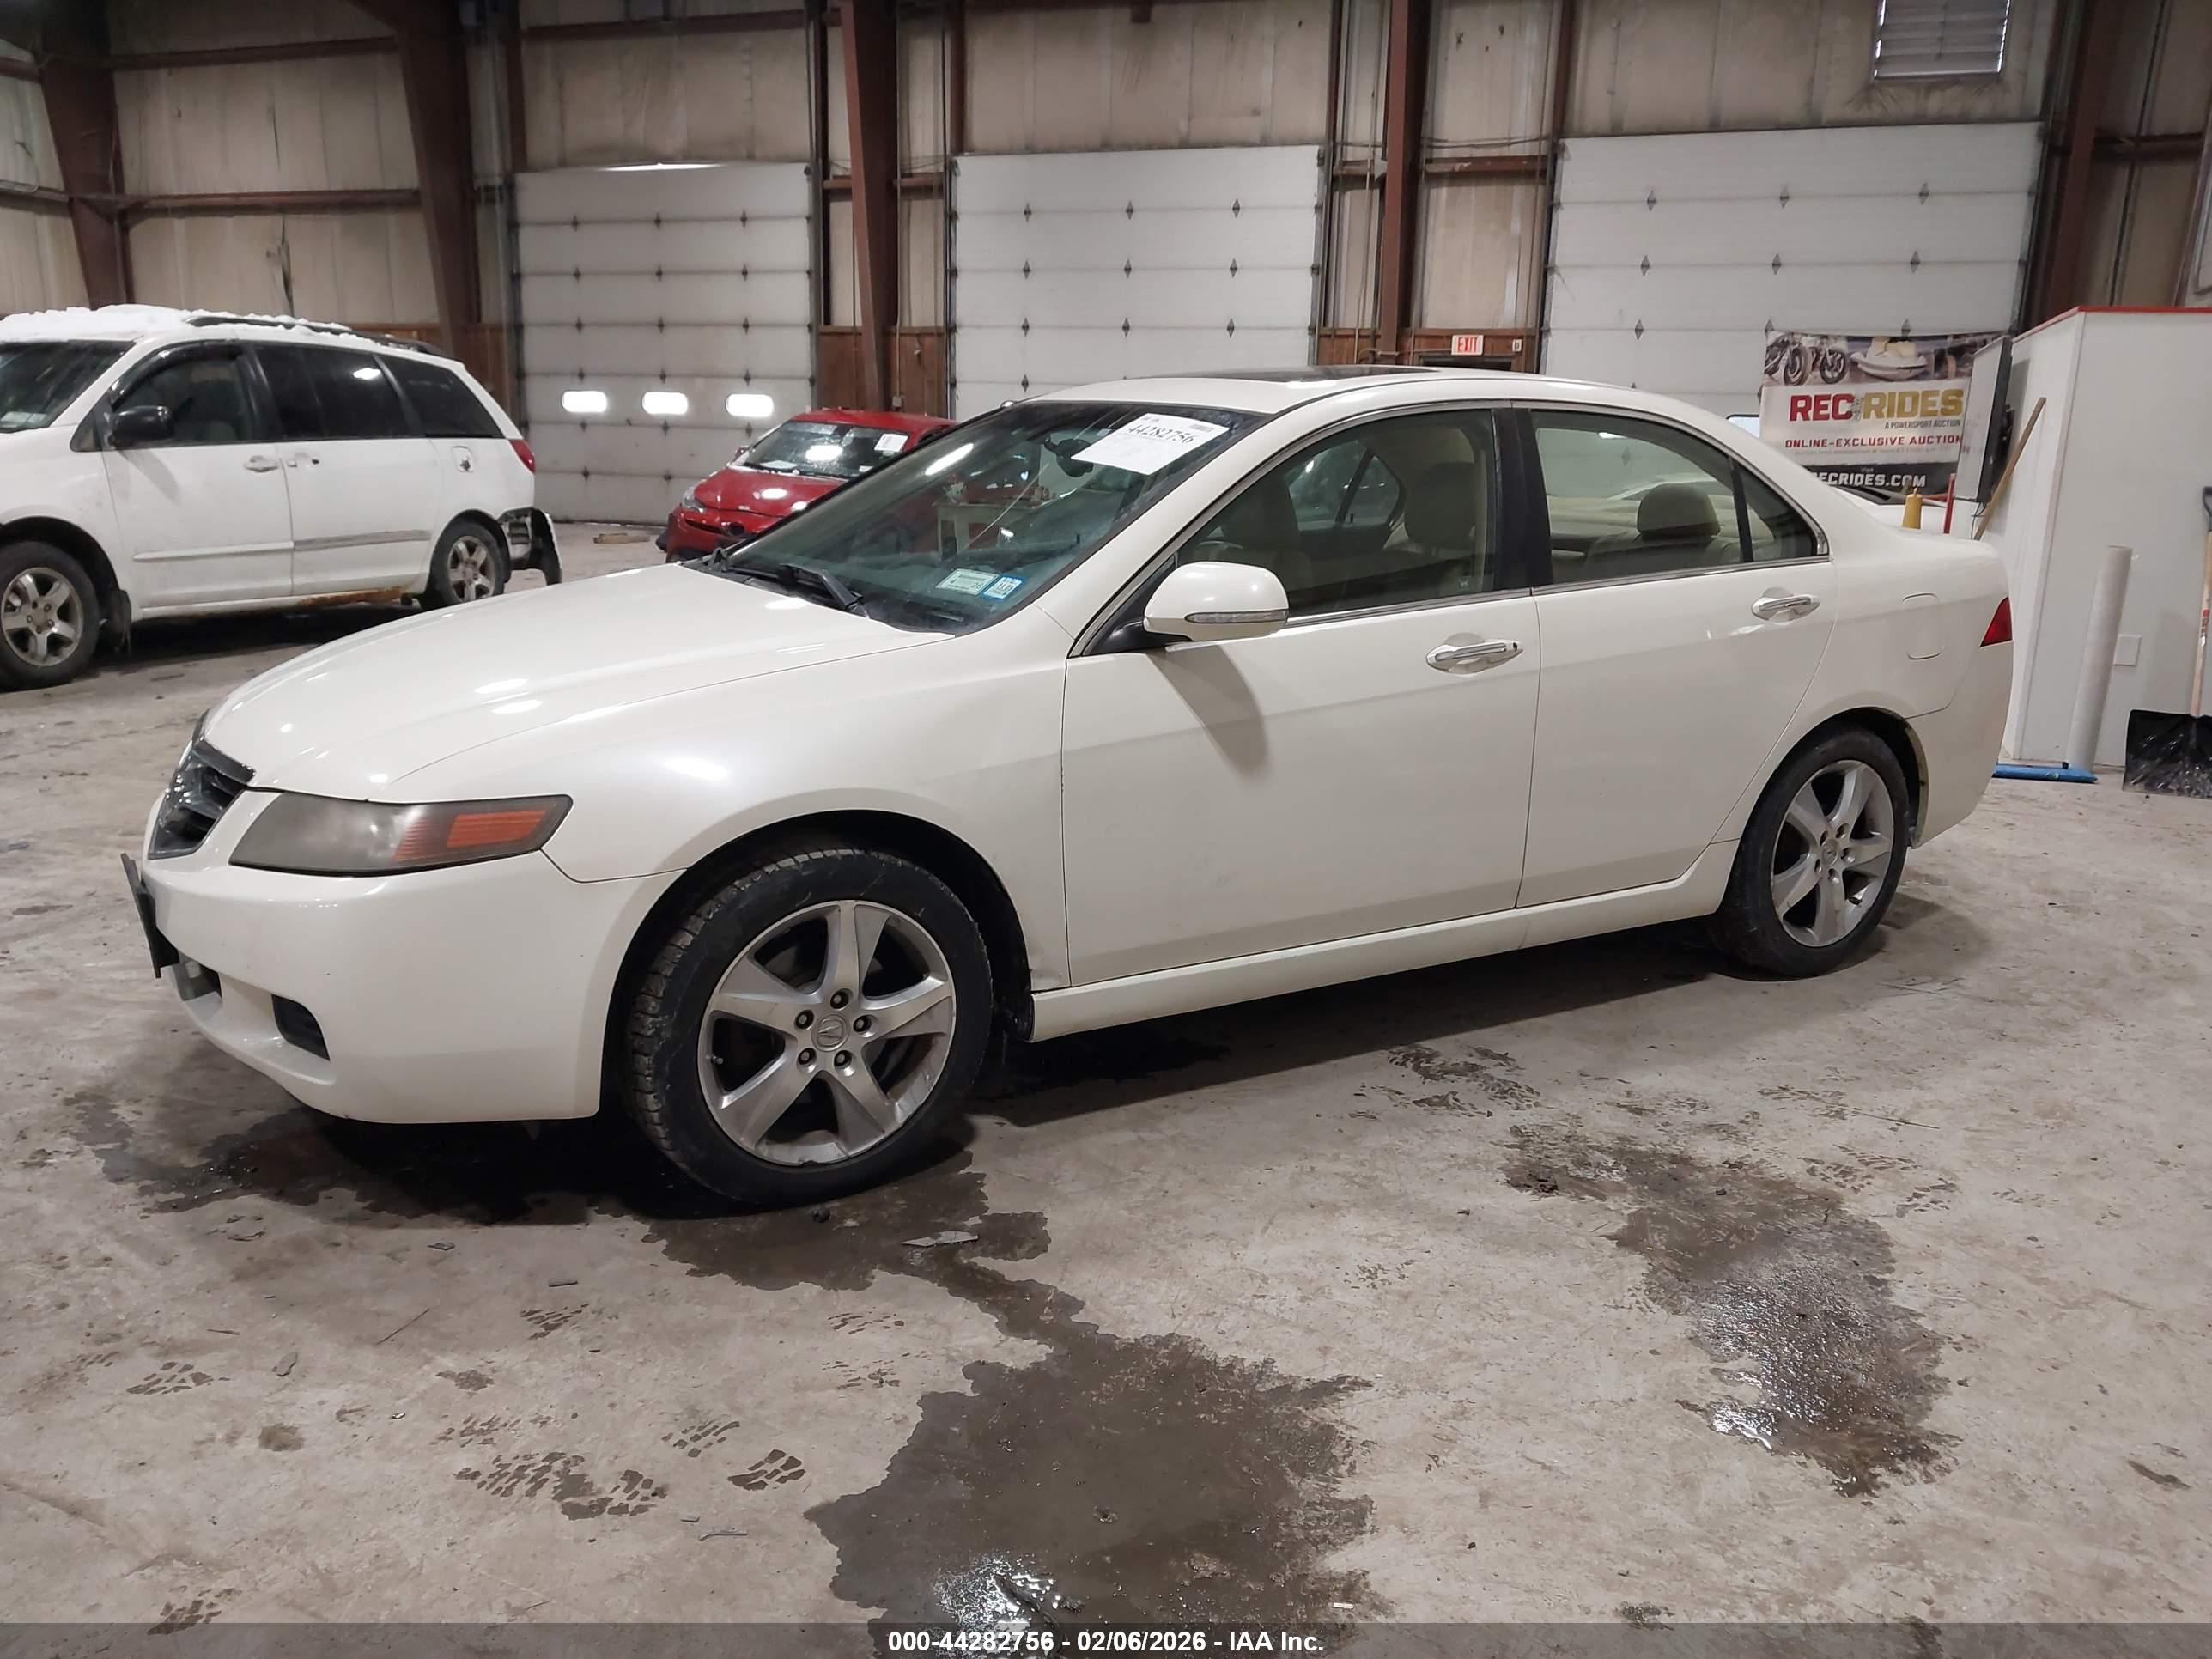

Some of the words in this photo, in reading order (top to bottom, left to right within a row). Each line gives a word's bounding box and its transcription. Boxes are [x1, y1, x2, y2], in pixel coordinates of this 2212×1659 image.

[1457, 336, 1479, 353] EXIT
[1789, 393, 1856, 422] REC
[1863, 388, 1965, 420] RIDES
[1934, 418, 1961, 428] AUCTION
[1128, 424, 1196, 444] 44282756
[1785, 435, 1905, 448] ONLINE-EXCLUSIVE
